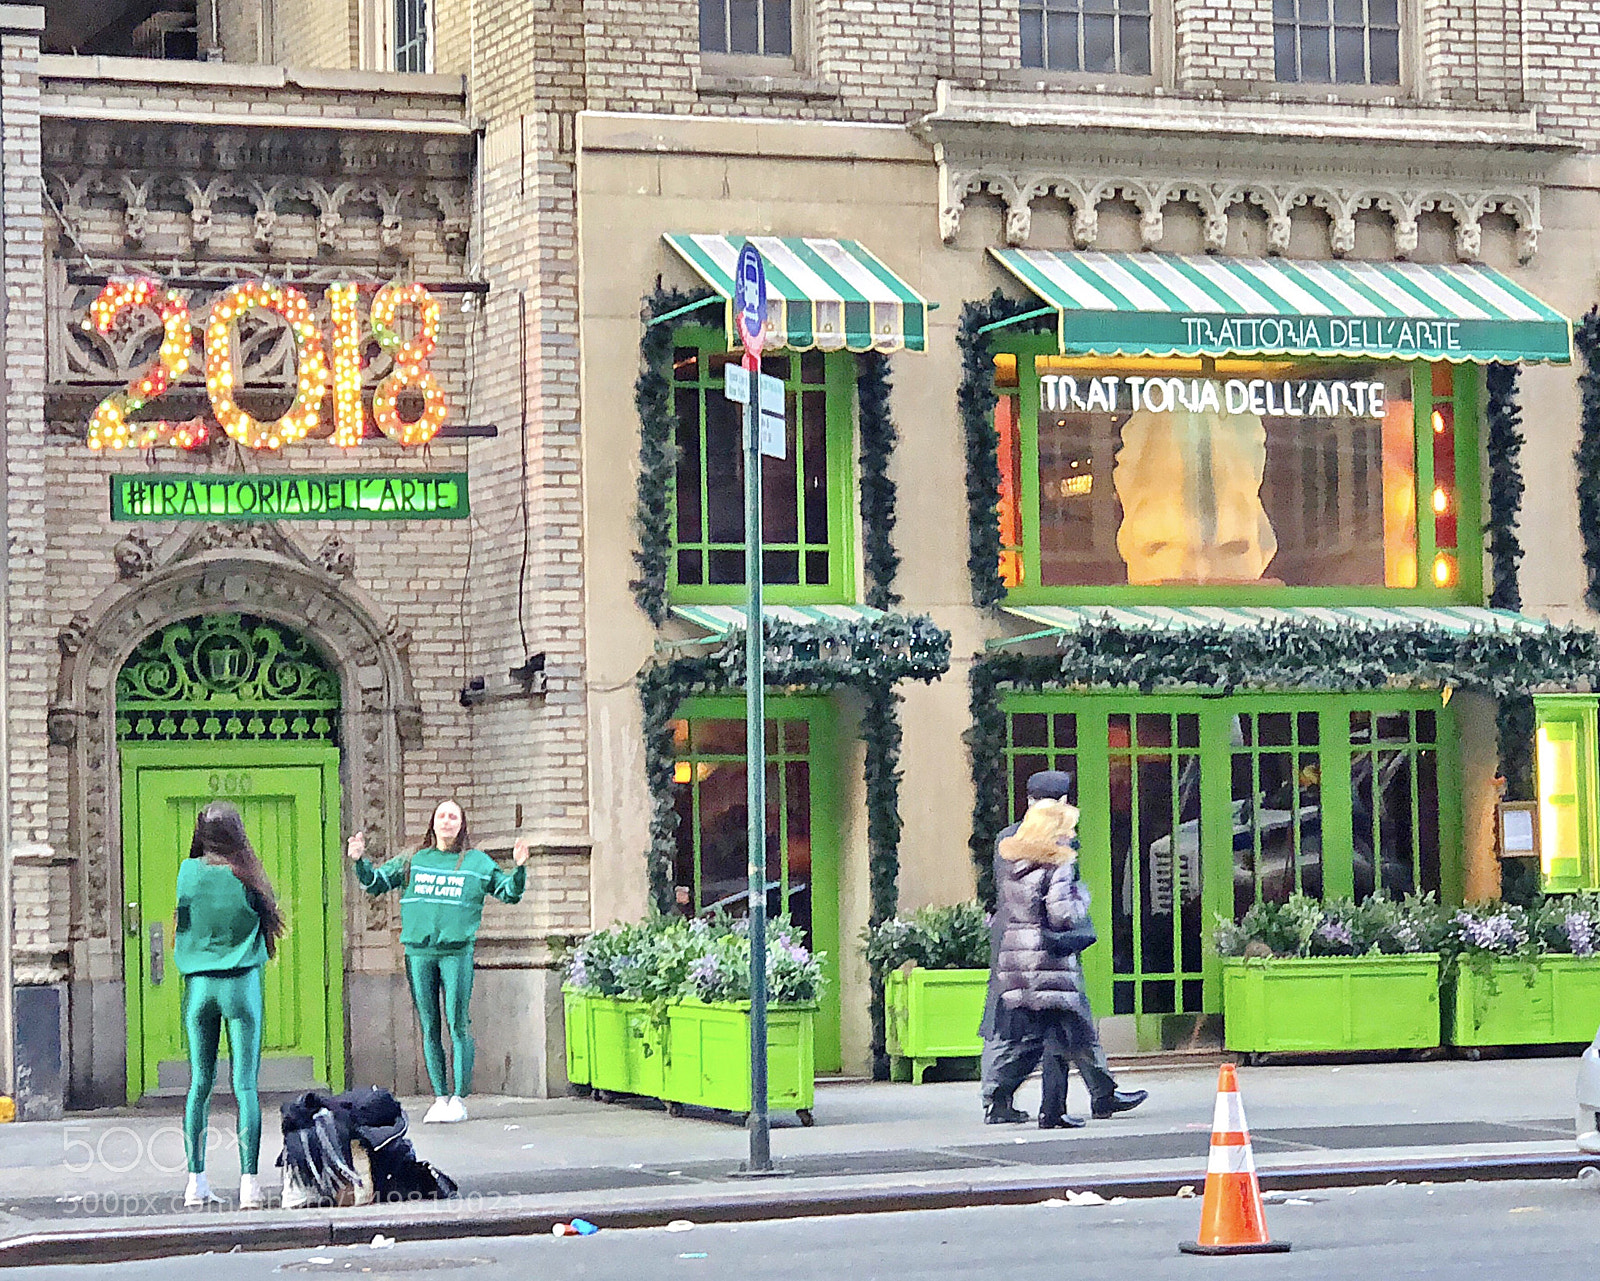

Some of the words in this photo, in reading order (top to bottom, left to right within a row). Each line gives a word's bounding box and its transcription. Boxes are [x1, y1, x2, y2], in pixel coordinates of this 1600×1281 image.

[1180, 316, 1322, 348] TRATTORIA
[1329, 319, 1461, 351] DELL'ARTE
[87, 277, 447, 450] 2018
[1039, 374, 1220, 415] TRATTORIA
[1224, 379, 1387, 418] DELL'ARTE
[127, 478, 453, 515] #TRATTORIADELL'ARTE
[414, 873, 436, 884] NOW
[447, 876, 465, 887] THE
[414, 884, 435, 894] NEW
[434, 885, 462, 897] LATER
